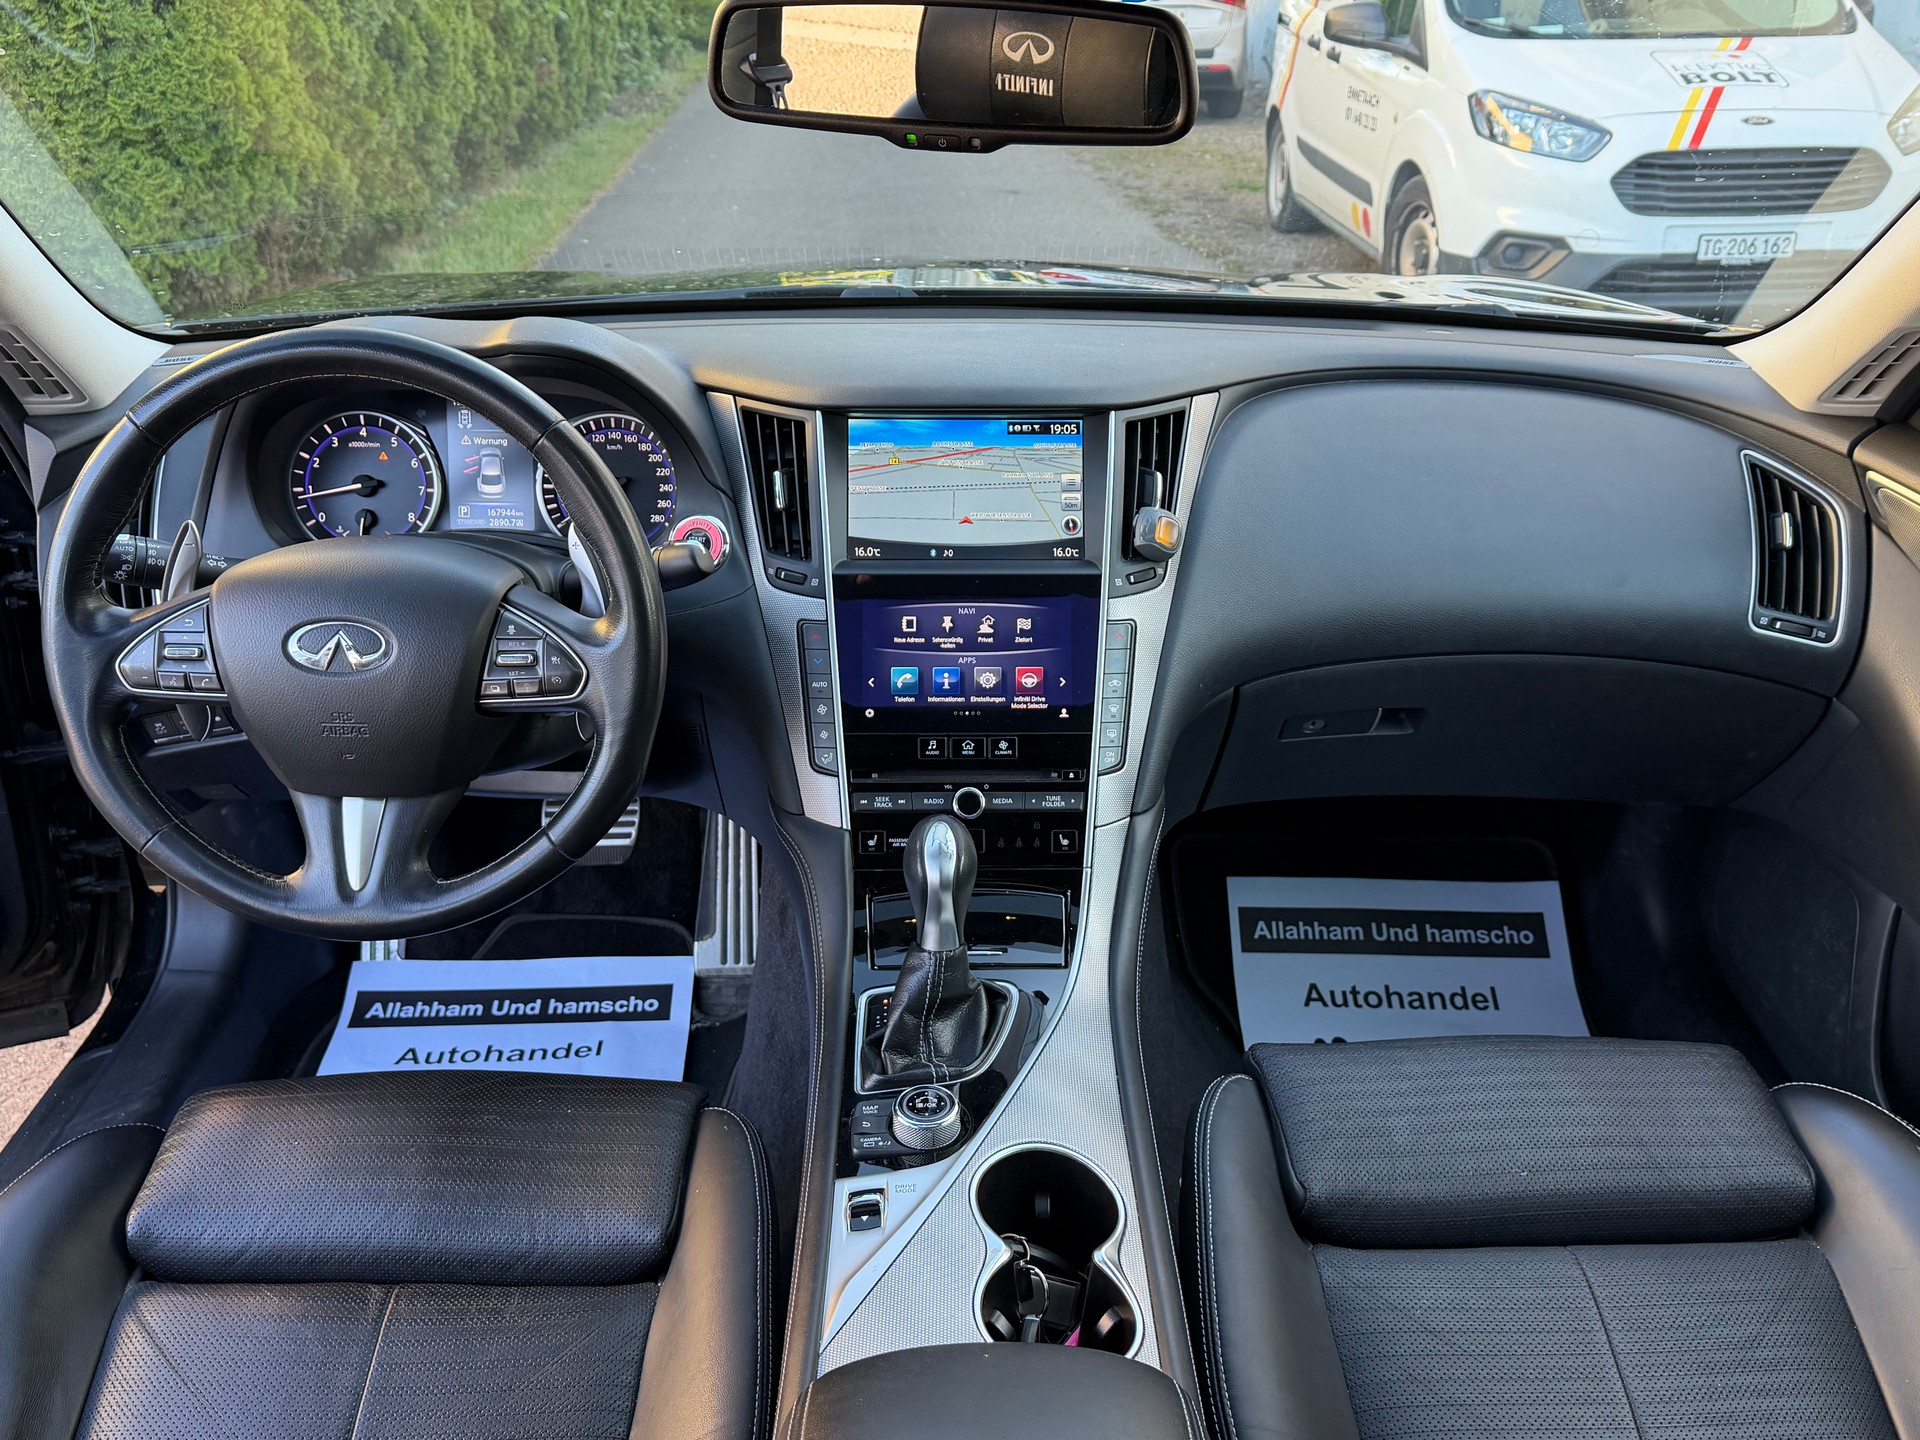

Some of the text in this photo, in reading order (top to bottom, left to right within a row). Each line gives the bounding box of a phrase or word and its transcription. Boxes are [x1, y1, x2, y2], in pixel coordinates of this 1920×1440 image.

[1680, 71, 1777, 85] BOLT
[1762, 236, 1792, 255] 162
[359, 427, 367, 438] 4
[1049, 423, 1078, 435] 19:05
[592, 434, 606, 442] 120
[608, 431, 622, 440] 140
[624, 434, 638, 443] 160
[331, 436, 339, 447] 3
[391, 437, 398, 447] 5
[473, 436, 508, 447] Warnung
[606, 443, 623, 451] km/h
[638, 442, 652, 452] 180
[312, 457, 320, 468] 2
[411, 457, 419, 468] 6
[648, 453, 663, 462] 200
[656, 467, 670, 476] 220
[418, 486, 425, 496] 7
[659, 483, 674, 492] 240
[657, 500, 672, 508] 260
[1064, 501, 1078, 509] 50m
[318, 512, 326, 523] 0
[408, 512, 415, 523] 8
[650, 514, 665, 523] 280
[958, 607, 976, 615] NAVI
[958, 657, 977, 665] APPS
[331, 711, 355, 723] SRS
[322, 725, 370, 738] AIRBAG
[1253, 919, 1534, 945] Allahham Und hamscho
[1303, 982, 1501, 1012] Autohandel
[364, 995, 659, 1020] Allahham Und hamscho
[393, 1040, 604, 1066] Autohandel
